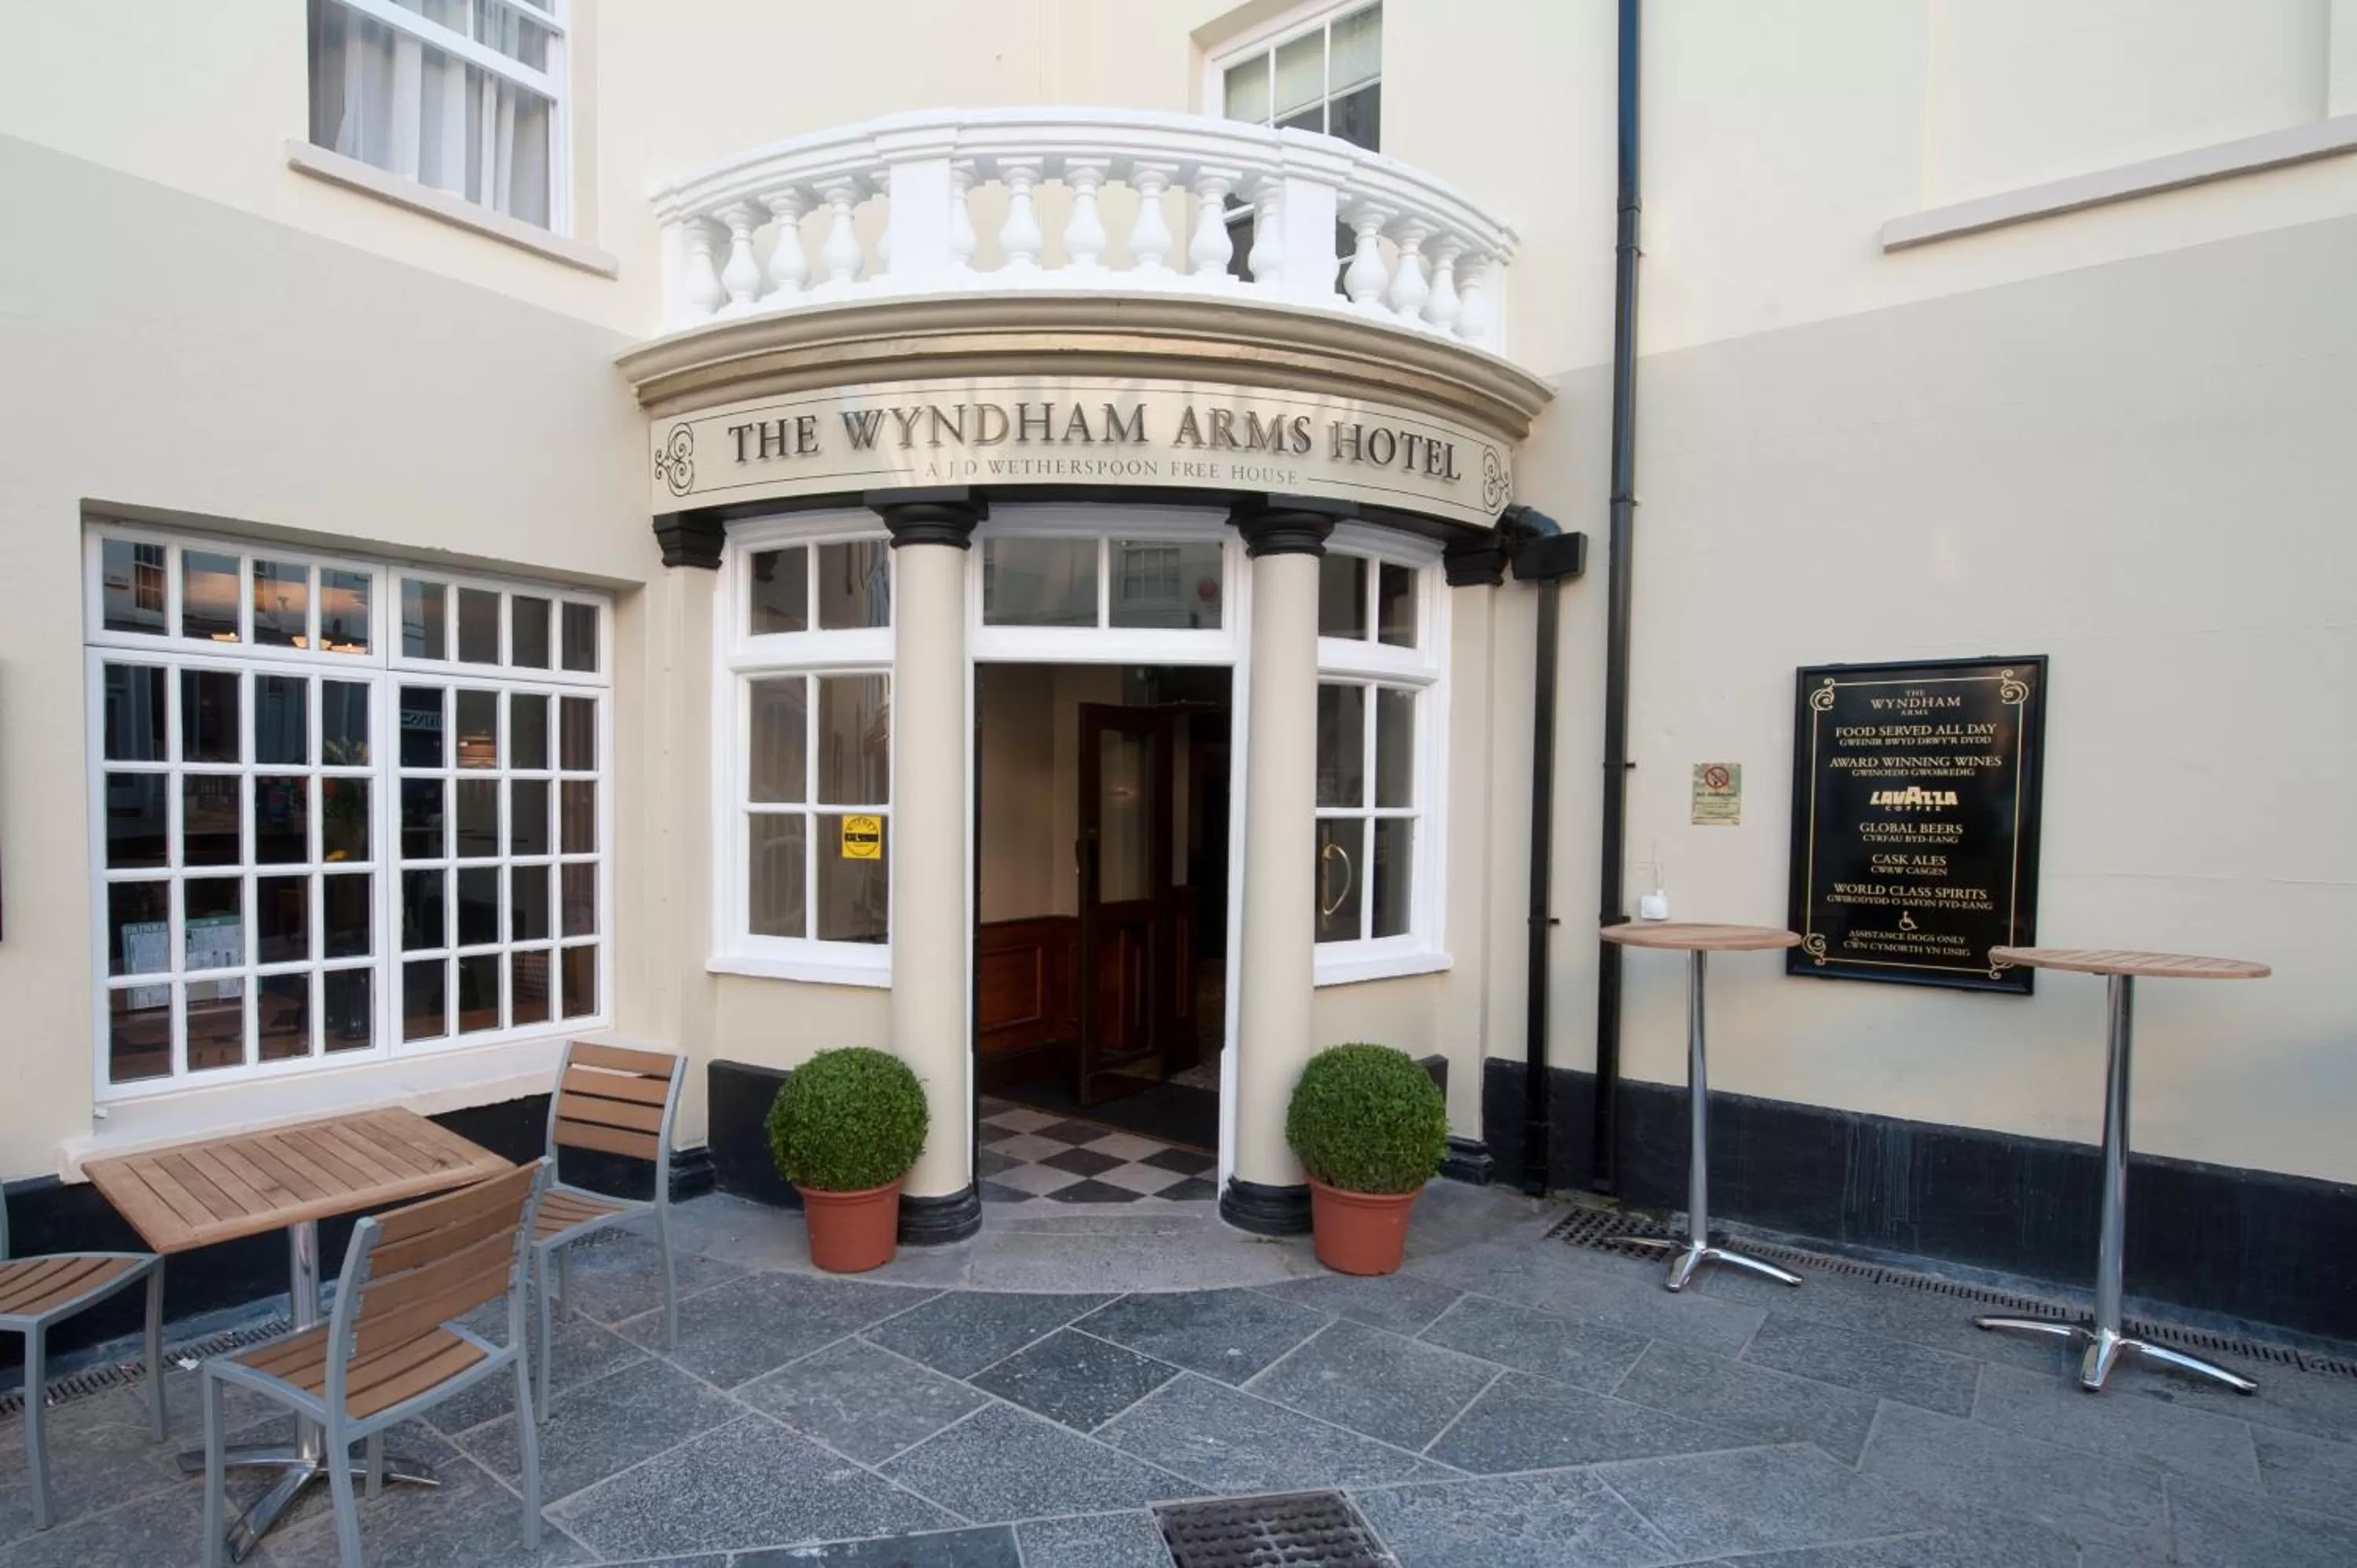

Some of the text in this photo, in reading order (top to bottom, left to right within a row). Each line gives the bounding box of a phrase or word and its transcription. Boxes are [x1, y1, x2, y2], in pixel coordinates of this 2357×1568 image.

[728, 403, 1462, 481] THE WYNDHAM ARMS HOTEL
[925, 462, 937, 478] A
[964, 460, 977, 476] D
[988, 459, 1158, 477] WETHERSPOON
[1170, 460, 1219, 479] FREE
[1231, 464, 1298, 485] HOUSE
[1870, 696, 1961, 709] WYNDHAM
[1835, 724, 1996, 738] FOOD SERVED ALL DAY
[1830, 756, 2002, 768] AWARD WINNING WINES
[1870, 786, 1958, 805] LAVAZZA
[1860, 822, 1963, 834] GLOBAL BEERS
[1905, 835, 1959, 844] BYD-EANG
[1872, 854, 1947, 866] CASK ALES
[1834, 883, 1987, 899] WORLD CLASS SPIRITS
[1891, 897, 1901, 906] O
[1849, 929, 1966, 945] ASSISTANCE DOGS ONLY
